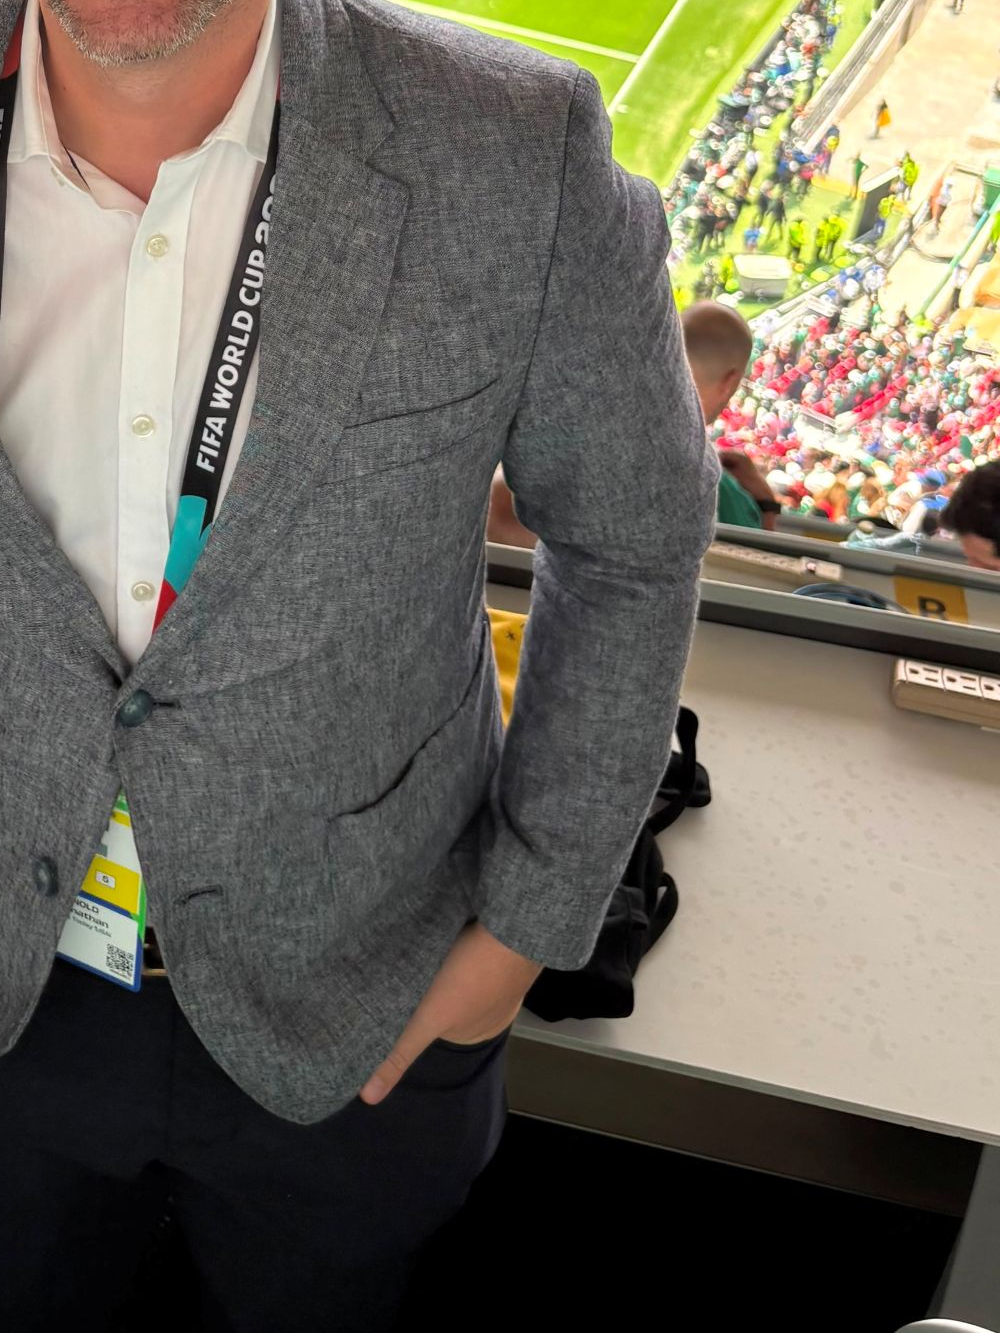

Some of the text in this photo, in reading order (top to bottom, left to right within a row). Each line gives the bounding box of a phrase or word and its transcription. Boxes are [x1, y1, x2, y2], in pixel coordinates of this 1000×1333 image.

[239, 249, 266, 307] CUP
[209, 309, 254, 411] WORLD
[196, 416, 227, 473] FIFA
